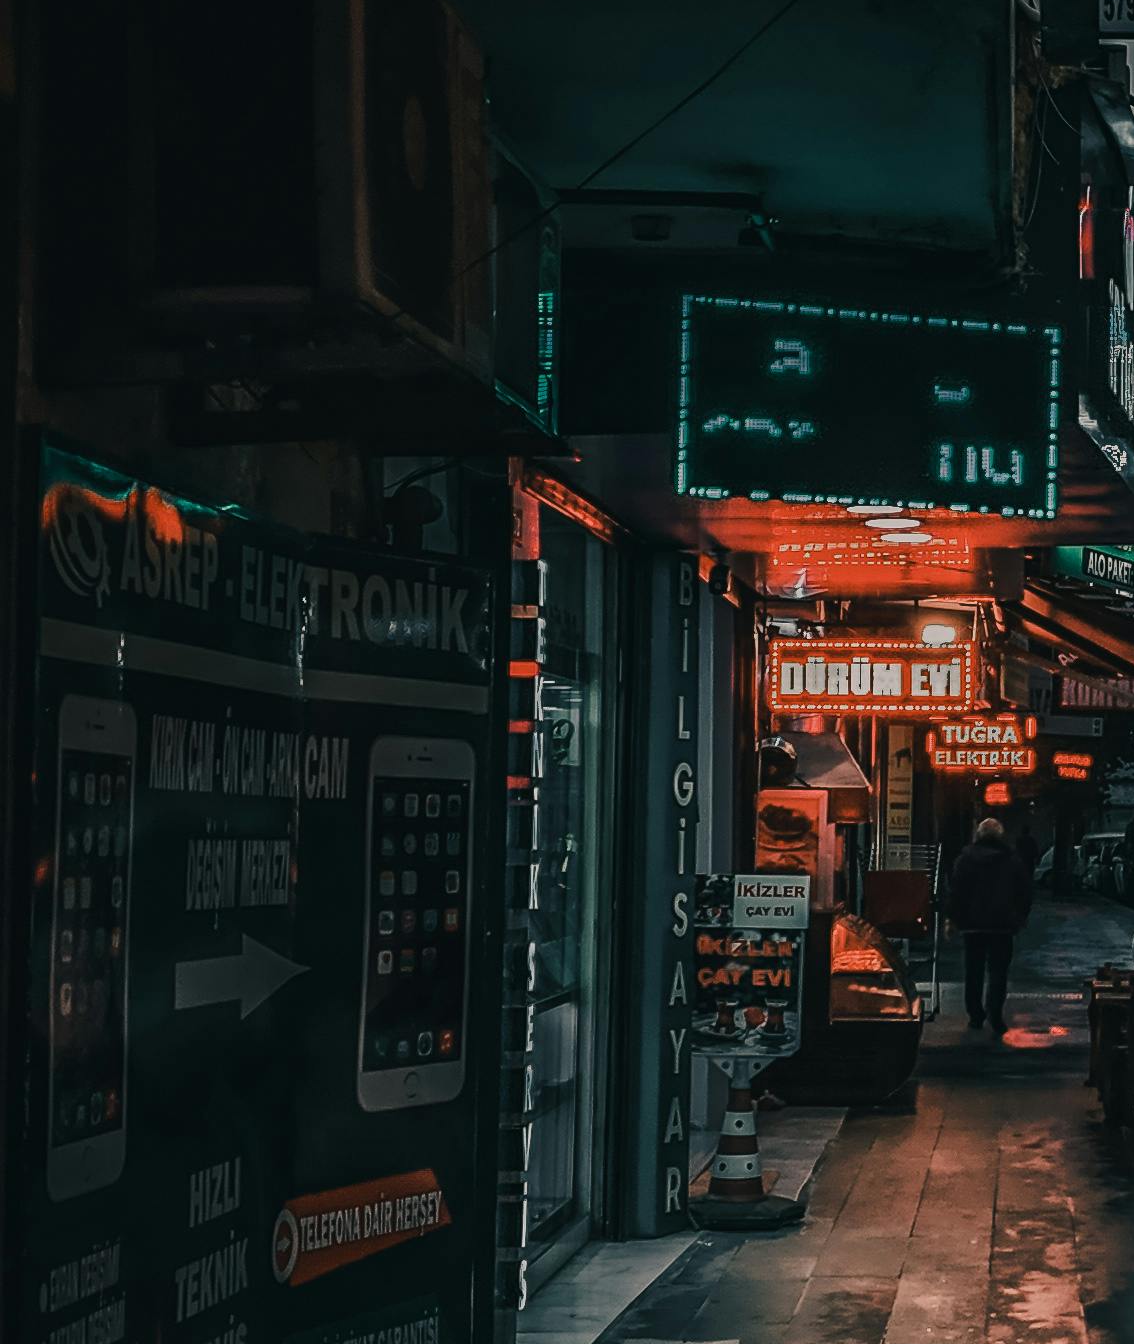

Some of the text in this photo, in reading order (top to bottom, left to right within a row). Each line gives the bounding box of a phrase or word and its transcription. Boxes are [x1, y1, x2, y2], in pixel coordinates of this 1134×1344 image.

[1087, 551, 1106, 579] ALO
[239, 544, 470, 655] ELEKTRONİK
[780, 656, 962, 697] DÜRÜM EVİ
[934, 747, 1026, 766] ELEKTRİK
[942, 720, 1019, 744] TUĞRA
[304, 734, 350, 800] CAM
[664, 559, 697, 1215] BİLGİSAYAR
[737, 881, 806, 898] İKİZLER
[745, 905, 795, 918] ÇAY EVİ
[188, 1155, 242, 1229] HIZLI
[300, 1205, 362, 1253] TELEFONA
[363, 1192, 393, 1239] DAİR
[174, 1228, 249, 1324] TEKNİK
